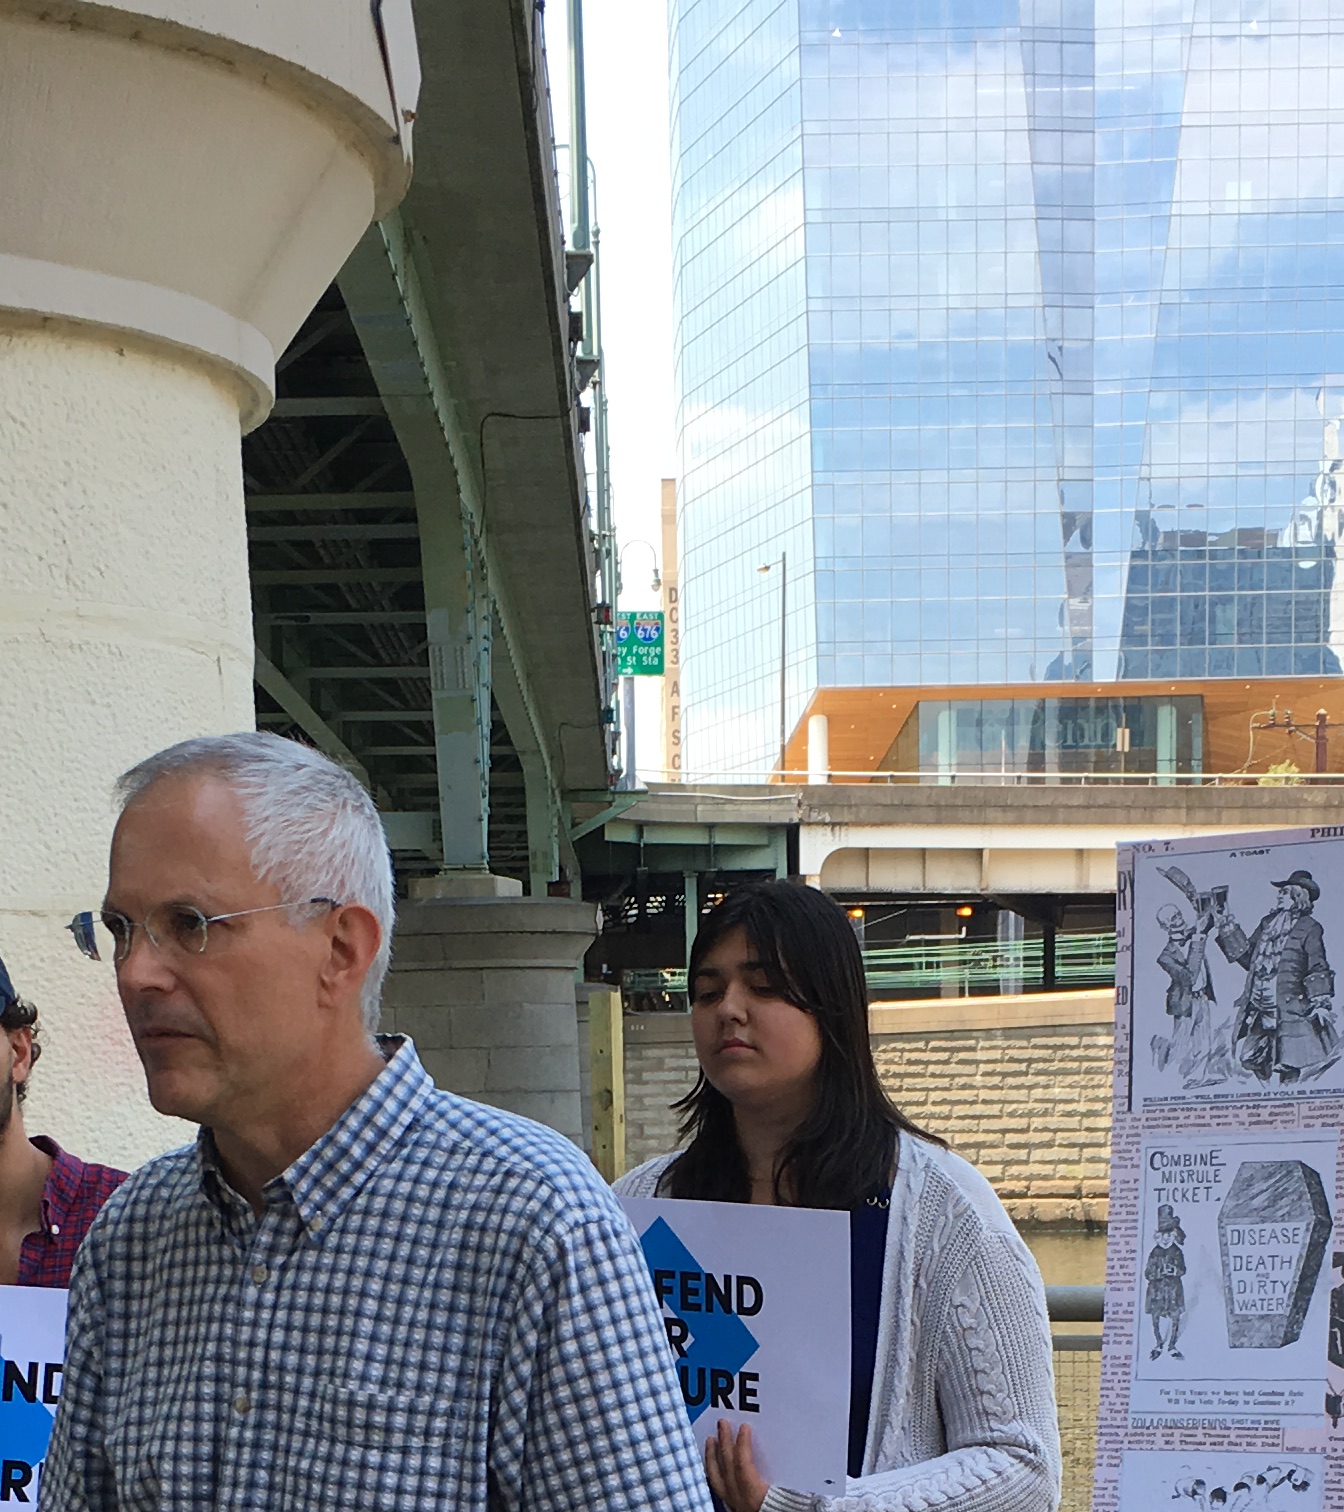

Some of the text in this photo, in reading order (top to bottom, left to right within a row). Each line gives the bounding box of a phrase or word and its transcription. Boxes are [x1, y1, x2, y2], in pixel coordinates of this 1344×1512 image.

[637, 625, 659, 639] 676
[632, 645, 662, 657] Forge
[1240, 850, 1271, 859] TOAST
[1149, 1149, 1227, 1171] COMBINE
[1160, 1169, 1222, 1186] MISRULE
[1229, 1226, 1301, 1247] DISEASE
[1232, 1254, 1293, 1273] DEATH
[652, 1268, 765, 1317] FEND
[1235, 1279, 1291, 1296] DIRTY
